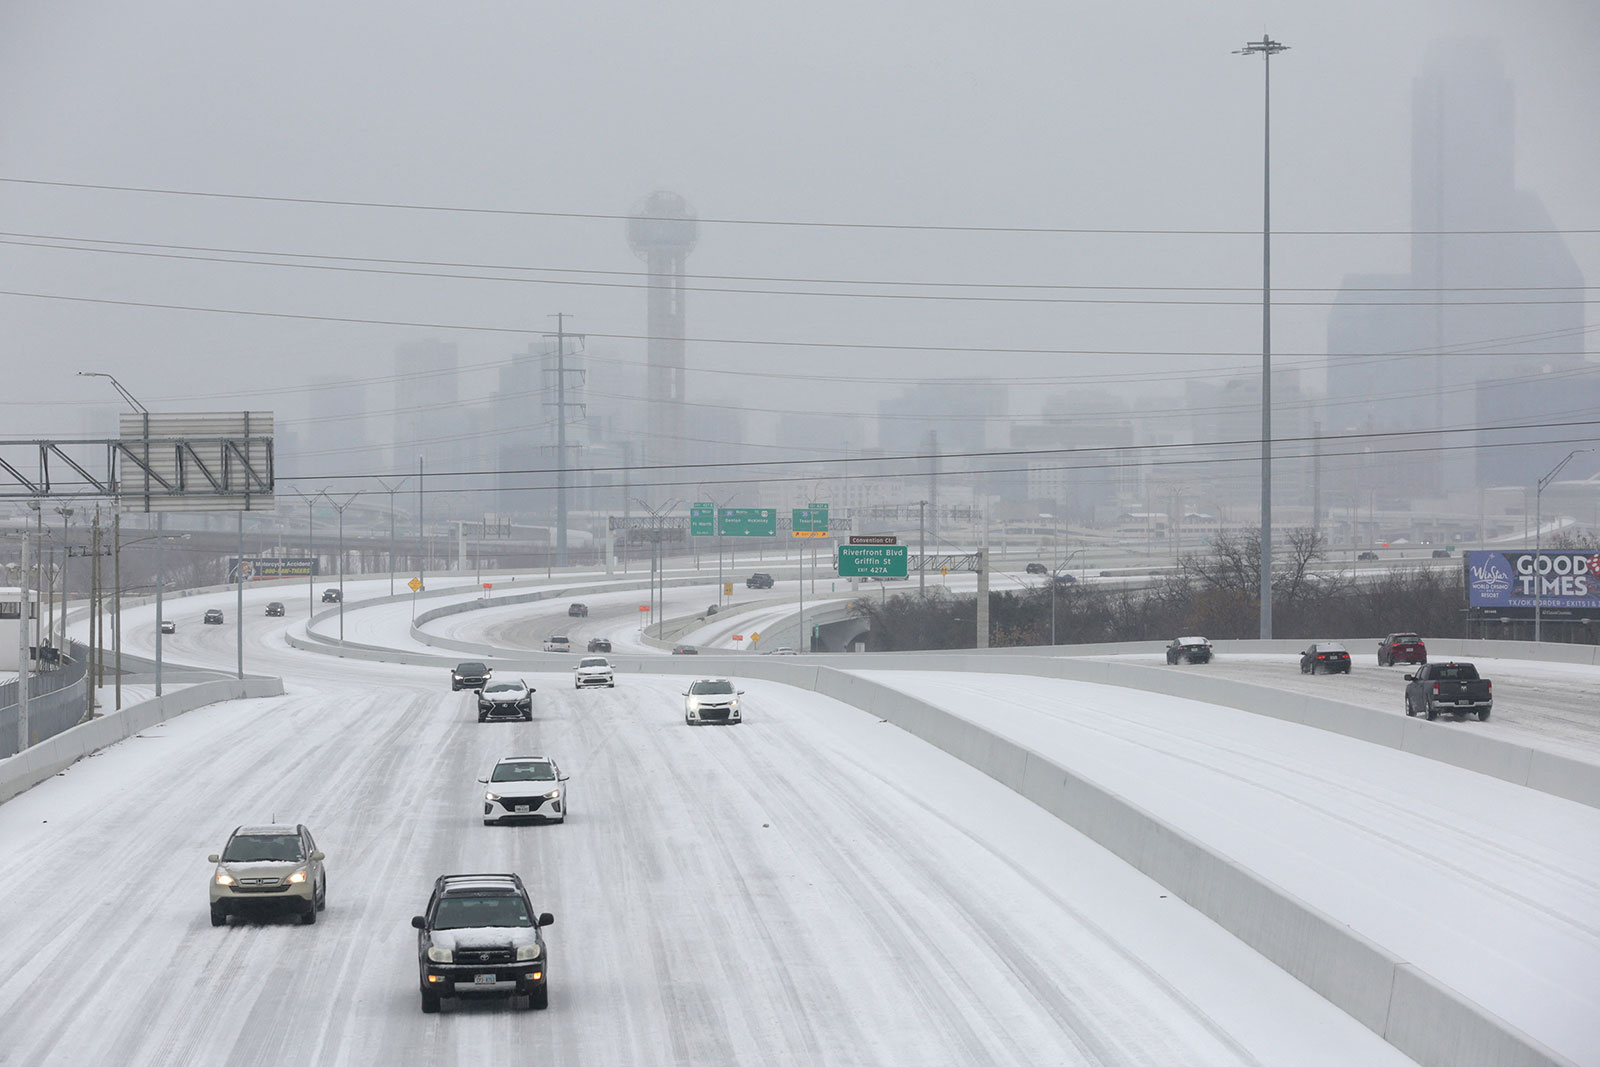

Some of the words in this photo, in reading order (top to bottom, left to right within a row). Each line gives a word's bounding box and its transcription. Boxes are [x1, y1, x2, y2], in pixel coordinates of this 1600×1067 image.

[1470, 560, 1508, 584] WinStar
[1516, 554, 1589, 575] GOOD
[1519, 576, 1588, 596] TIMES
[1508, 599, 1532, 607] TX/OK
